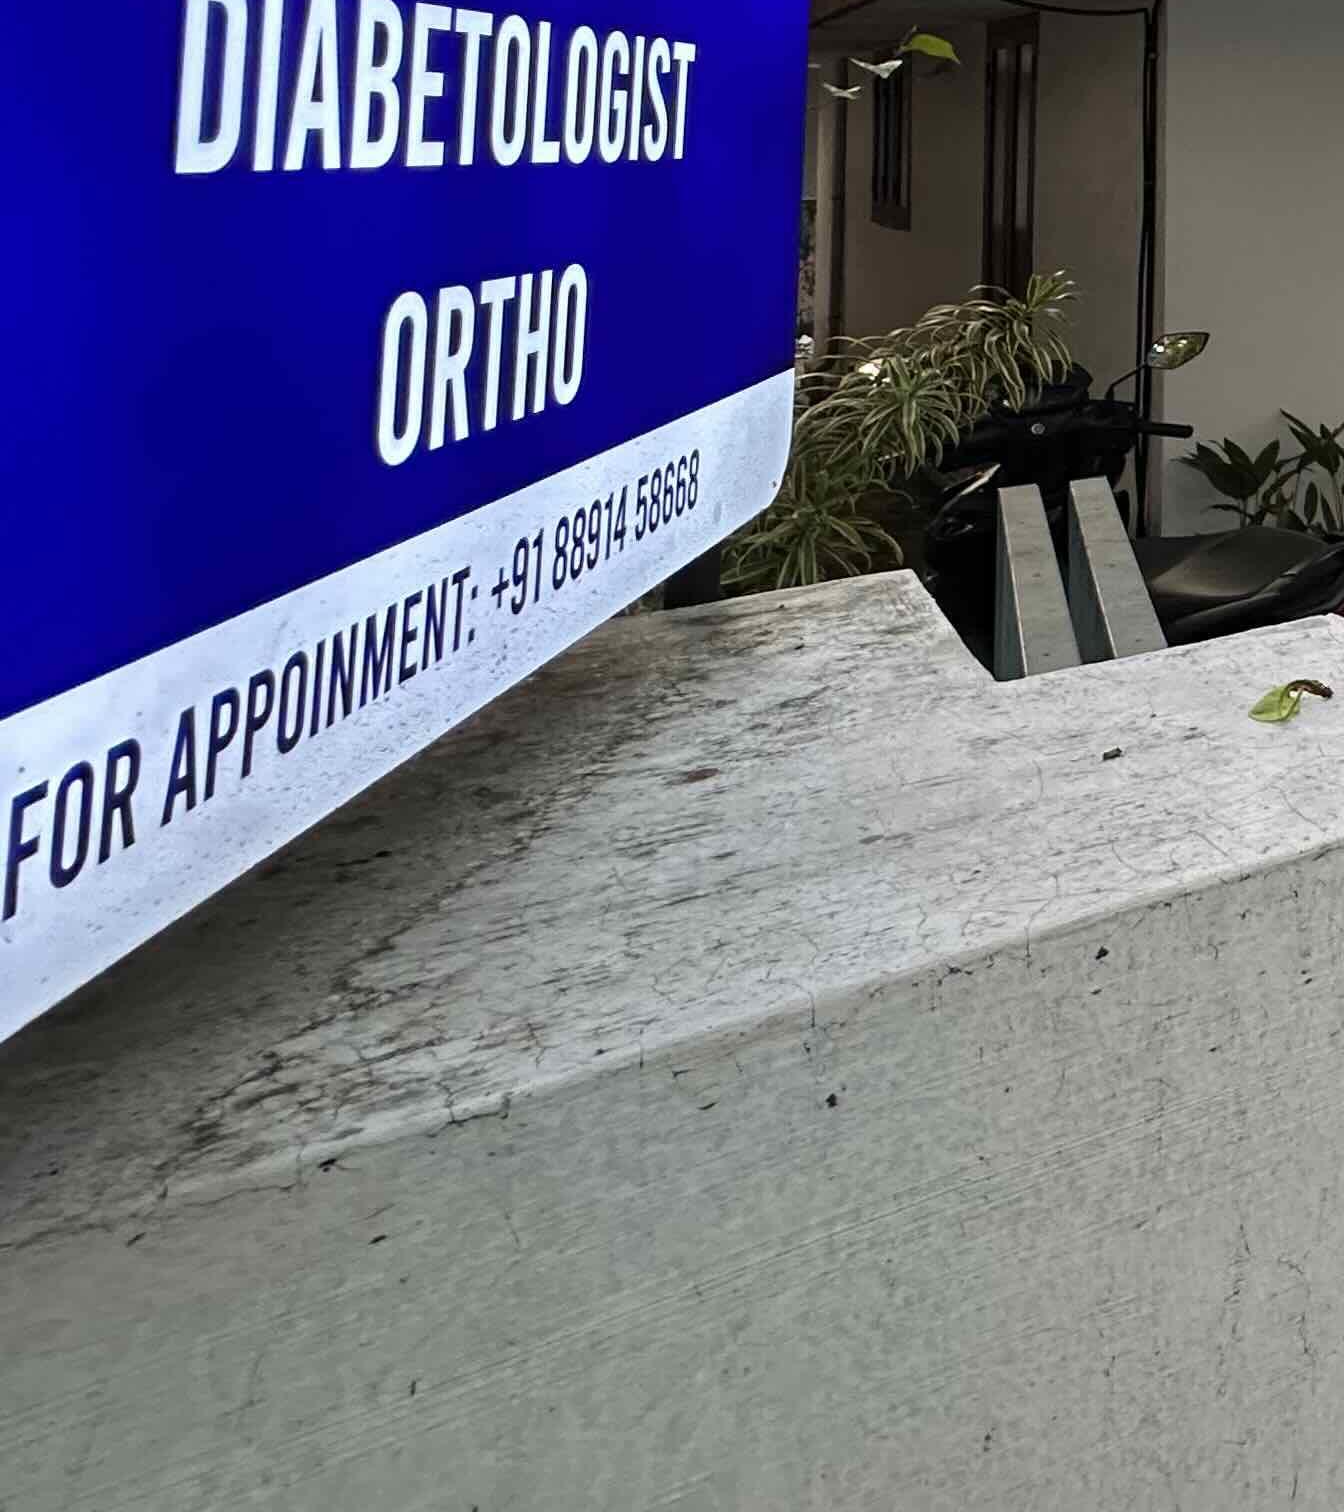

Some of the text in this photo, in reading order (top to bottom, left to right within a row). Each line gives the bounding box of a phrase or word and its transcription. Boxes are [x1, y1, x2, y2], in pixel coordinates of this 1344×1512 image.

[376, 263, 589, 466] ORTHO
[2, 449, 701, 922] FOR APPOINMENT: +91 88914 58668
